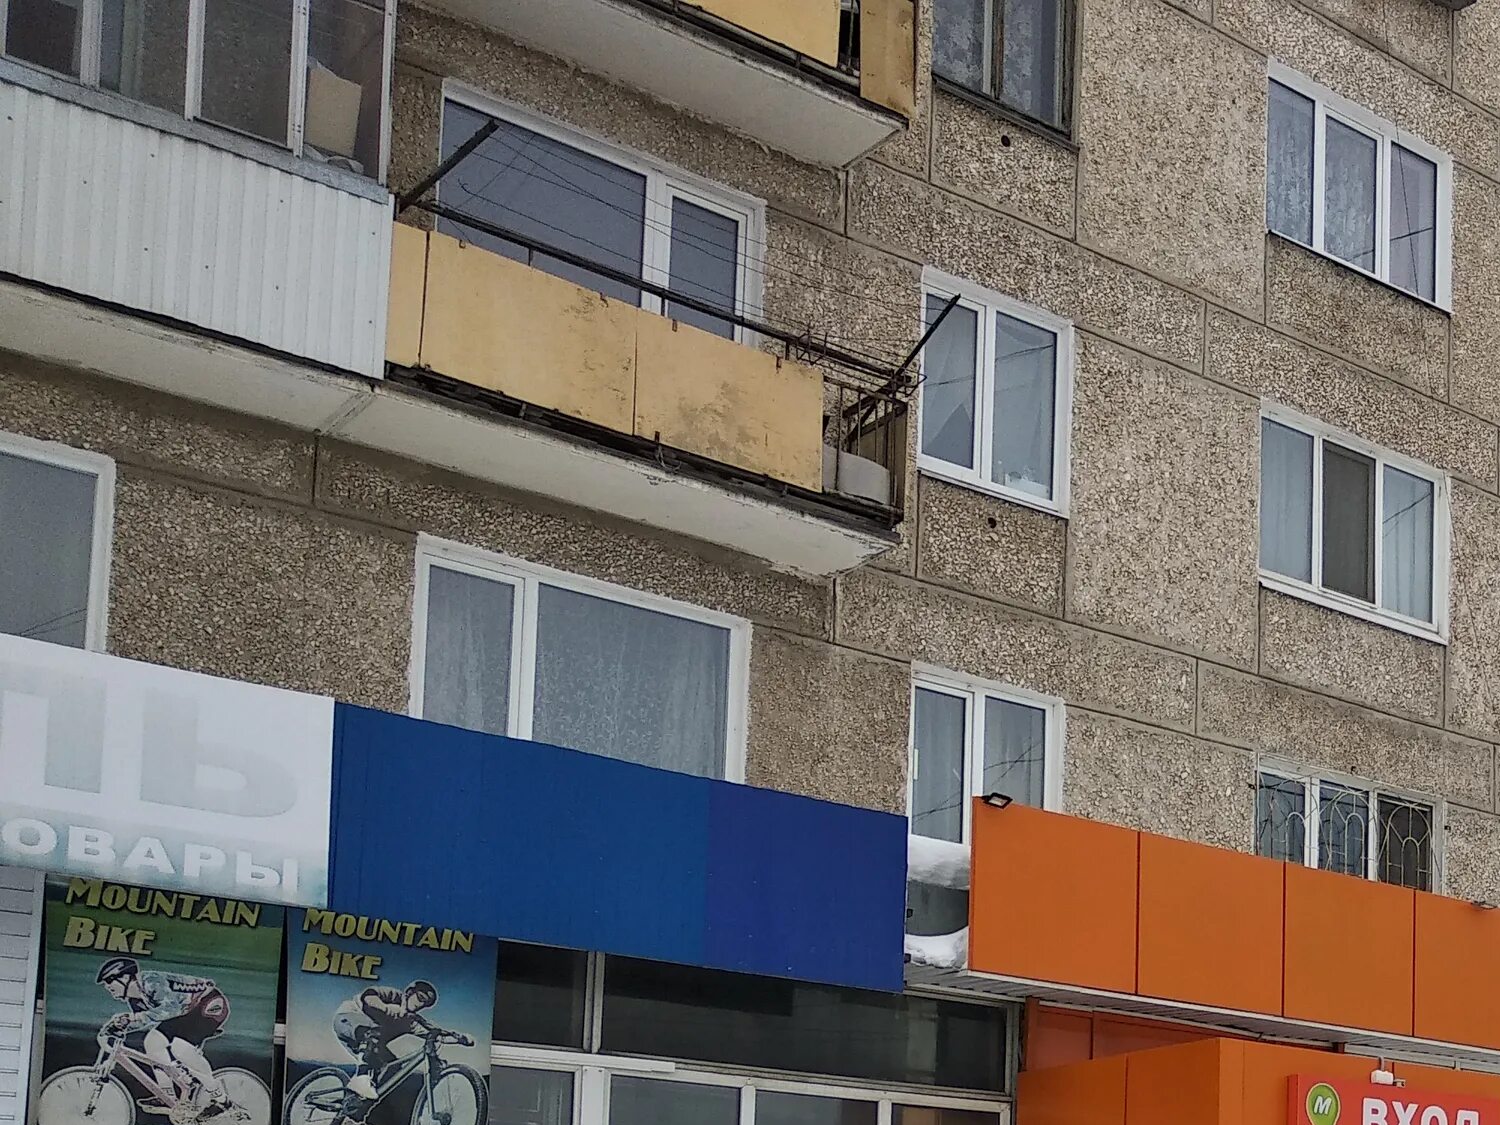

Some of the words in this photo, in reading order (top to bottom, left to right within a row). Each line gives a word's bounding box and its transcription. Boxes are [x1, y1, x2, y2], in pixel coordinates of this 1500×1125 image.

[65, 878, 261, 928] MOUNTAIN
[63, 915, 158, 957] BIKE
[302, 907, 475, 953] MOUNTAIN
[302, 943, 382, 981] BIKE
